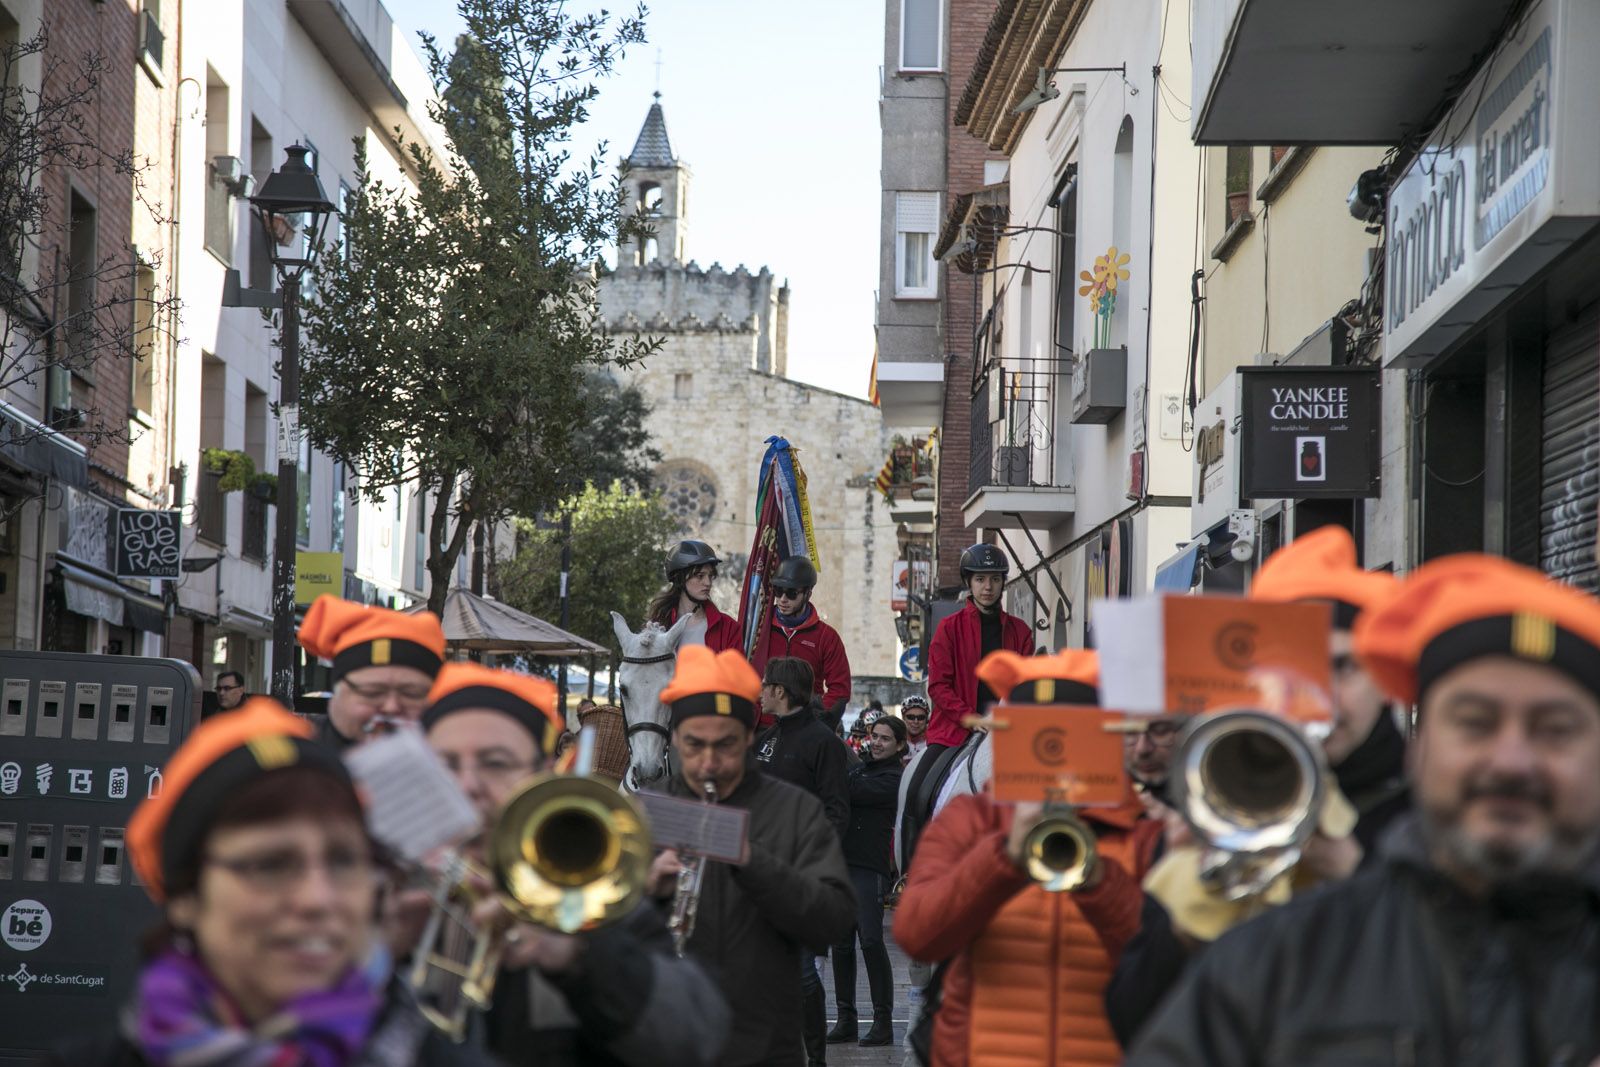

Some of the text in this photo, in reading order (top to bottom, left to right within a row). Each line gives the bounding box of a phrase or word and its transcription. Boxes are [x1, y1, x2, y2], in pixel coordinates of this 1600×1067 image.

[1271, 387, 1348, 403] YANKEE
[1270, 403, 1348, 420] CANDLE
[121, 511, 172, 534] LLON
[128, 546, 179, 572] RAS
[10, 906, 45, 915] Separar
[8, 915, 43, 937] bé
[40, 973, 104, 987] de SantCugat
